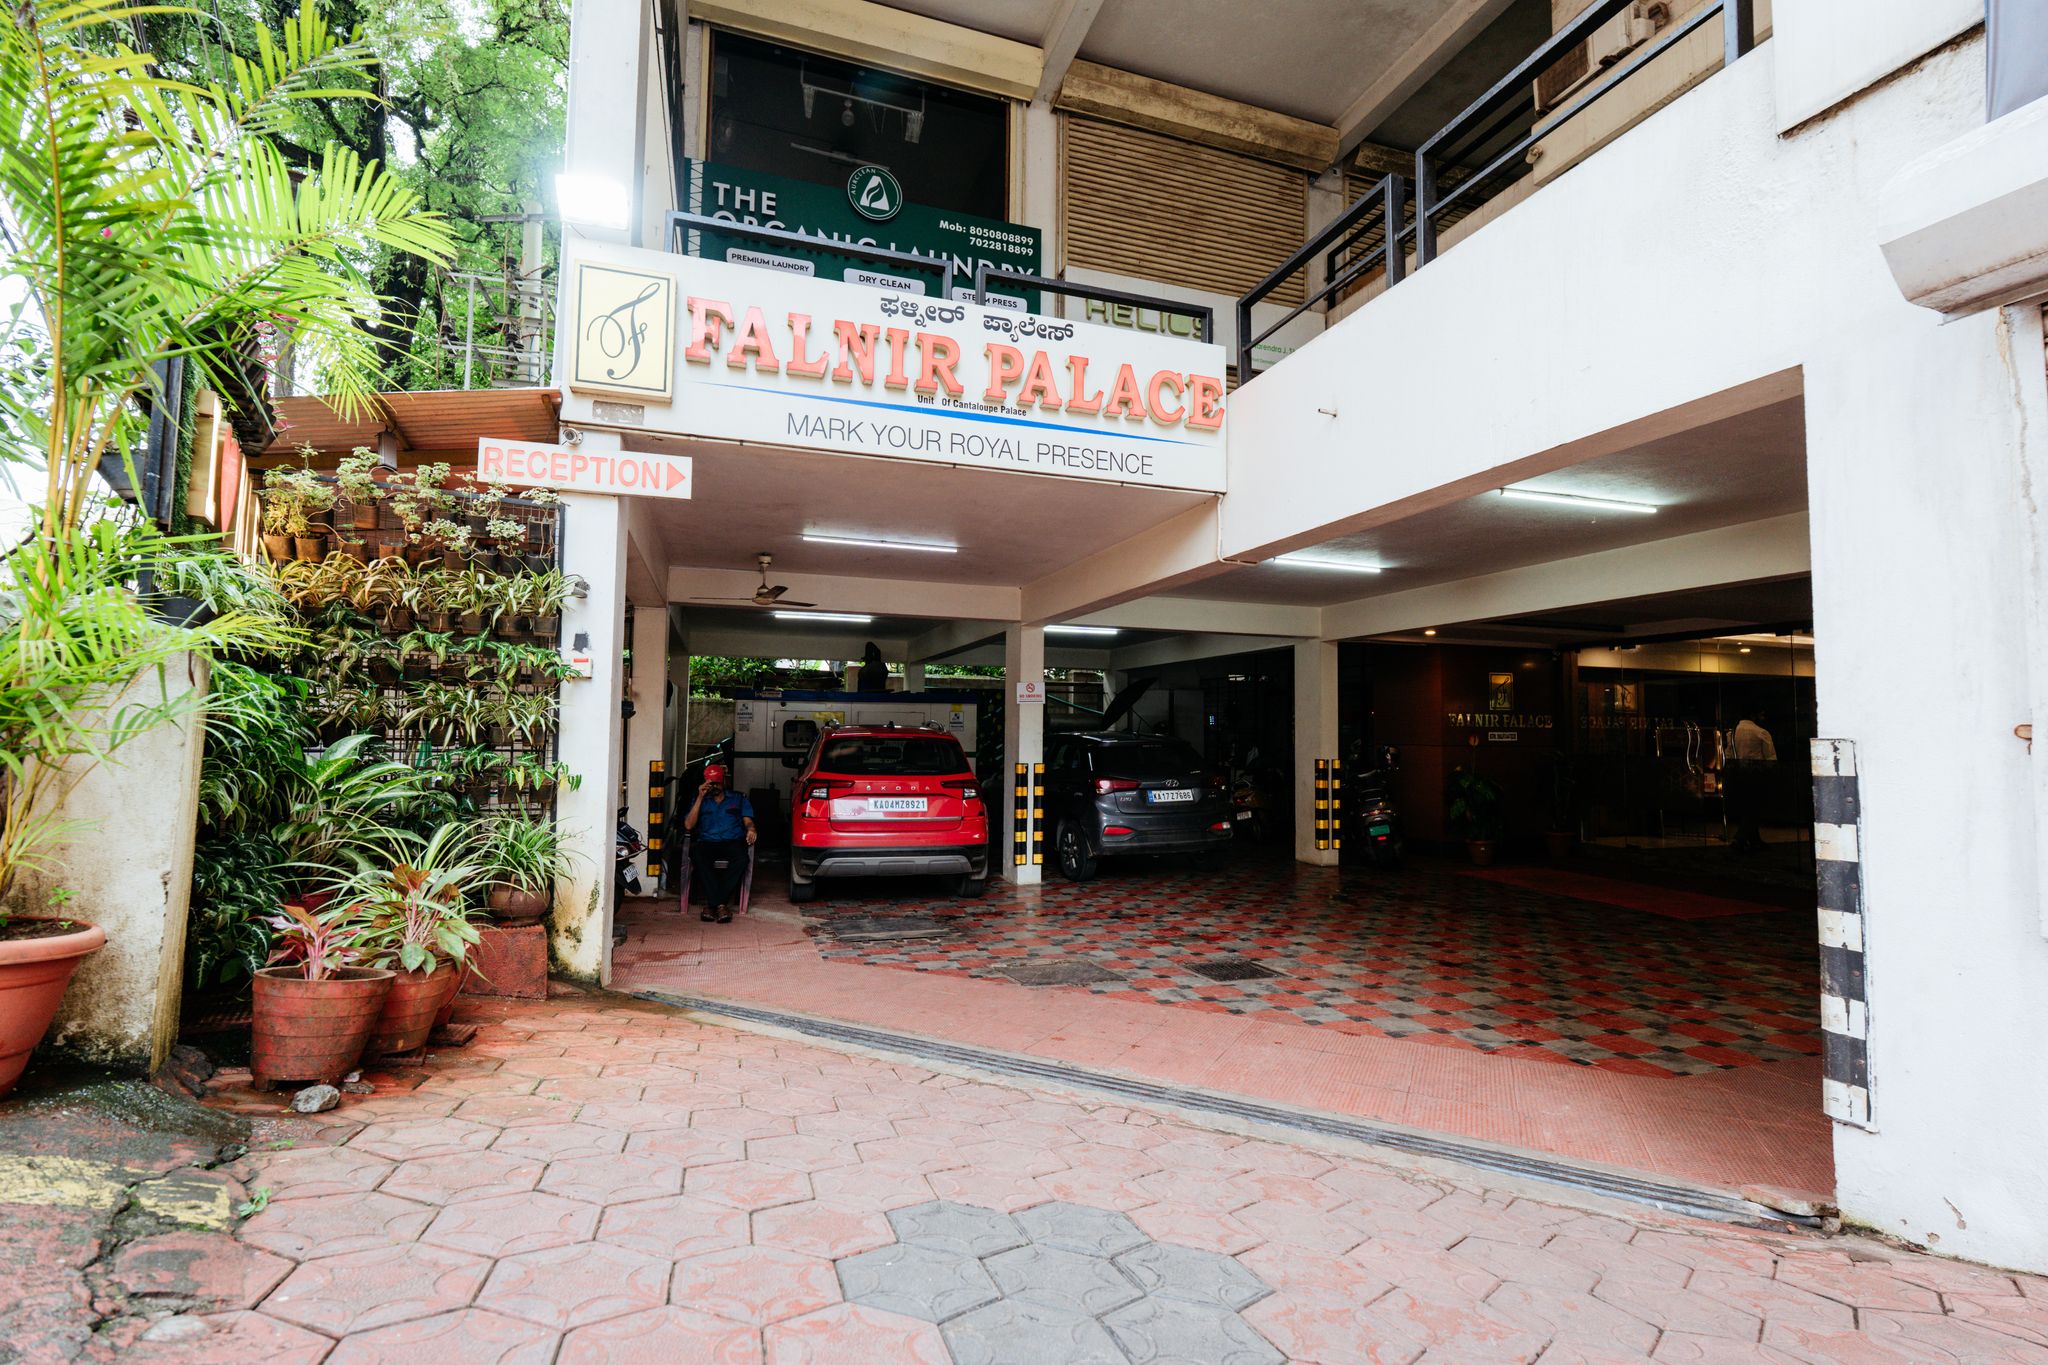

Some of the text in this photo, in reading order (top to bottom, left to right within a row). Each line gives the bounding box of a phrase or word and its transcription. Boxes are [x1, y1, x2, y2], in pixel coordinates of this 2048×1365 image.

[712, 181, 777, 216] THE
[939, 219, 1034, 246] Mob: 8050808899
[968, 236, 1034, 257] 7022818899
[731, 252, 810, 273] PREMIUM LAUNDRY
[858, 274, 911, 290] DRY CLEAN
[962, 292, 1018, 309] STEM PRESS
[685, 296, 1225, 431] FALNIR PALACE
[917, 394, 1027, 416] Unit Of Cantaloupe Palace
[787, 412, 1154, 476] MARK YOUR ROYAL PRESENCE
[483, 446, 661, 490] RECEPTION
